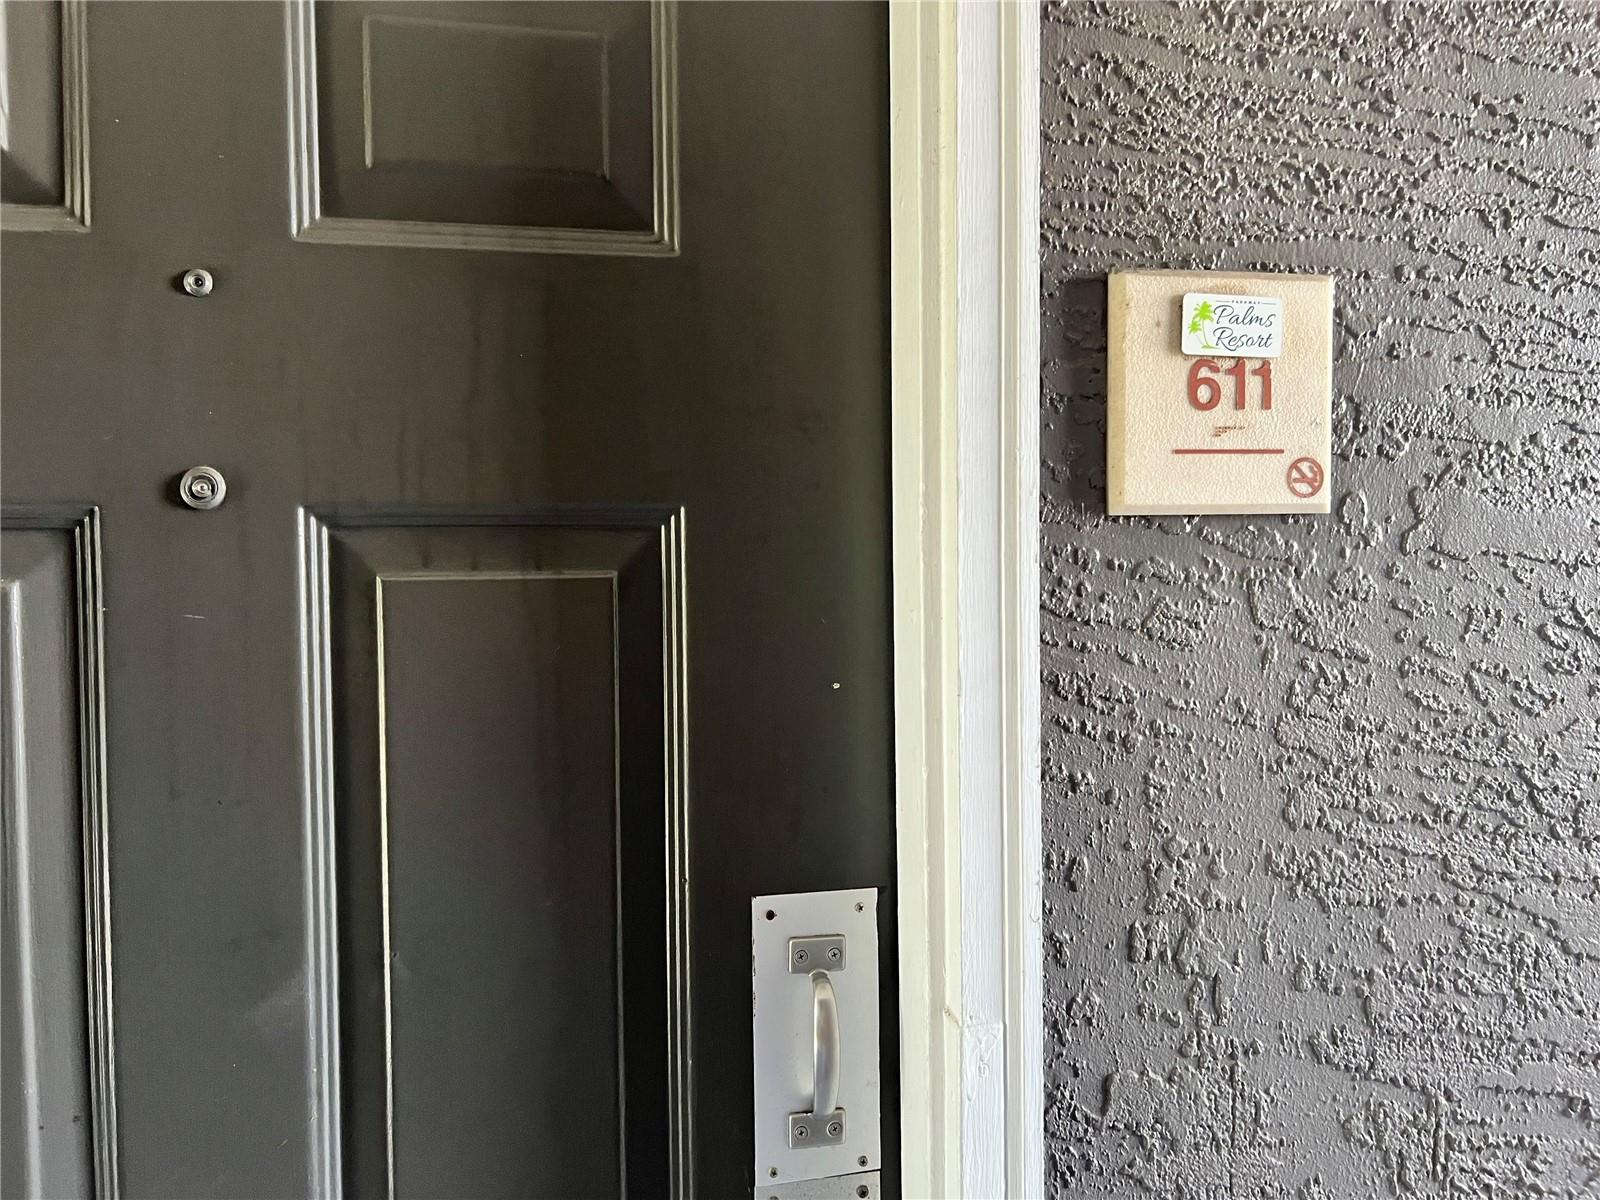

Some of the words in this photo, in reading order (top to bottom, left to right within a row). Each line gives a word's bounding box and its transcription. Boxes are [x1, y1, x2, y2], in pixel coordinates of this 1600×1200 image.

[1213, 304, 1277, 328] Palms
[1212, 326, 1273, 352] Resort
[1187, 358, 1272, 411] 611
